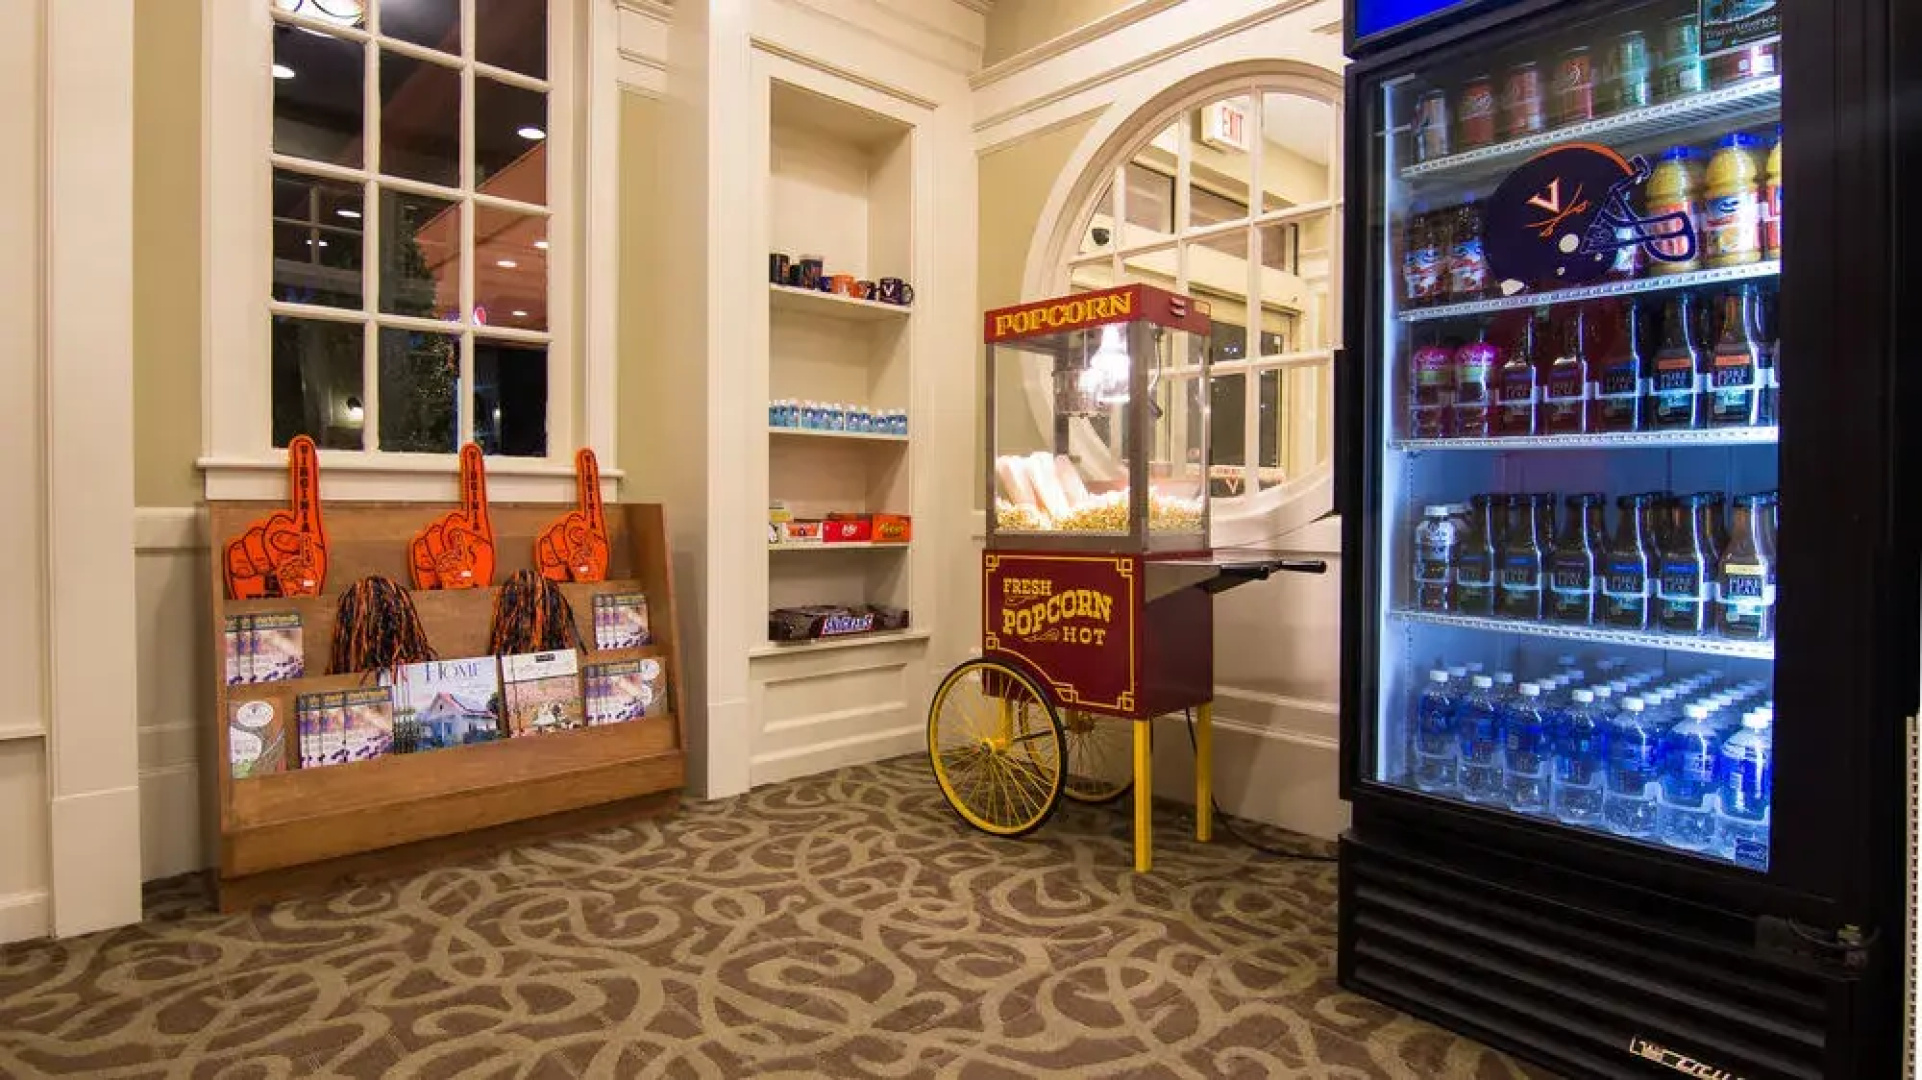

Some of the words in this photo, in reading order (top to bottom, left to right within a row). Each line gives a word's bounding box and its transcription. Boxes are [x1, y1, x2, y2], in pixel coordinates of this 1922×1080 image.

[994, 292, 1132, 336] POPCORN
[1003, 578, 1052, 596] FRESH
[1002, 590, 1114, 635] POPCORN
[1062, 626, 1106, 646] HOT
